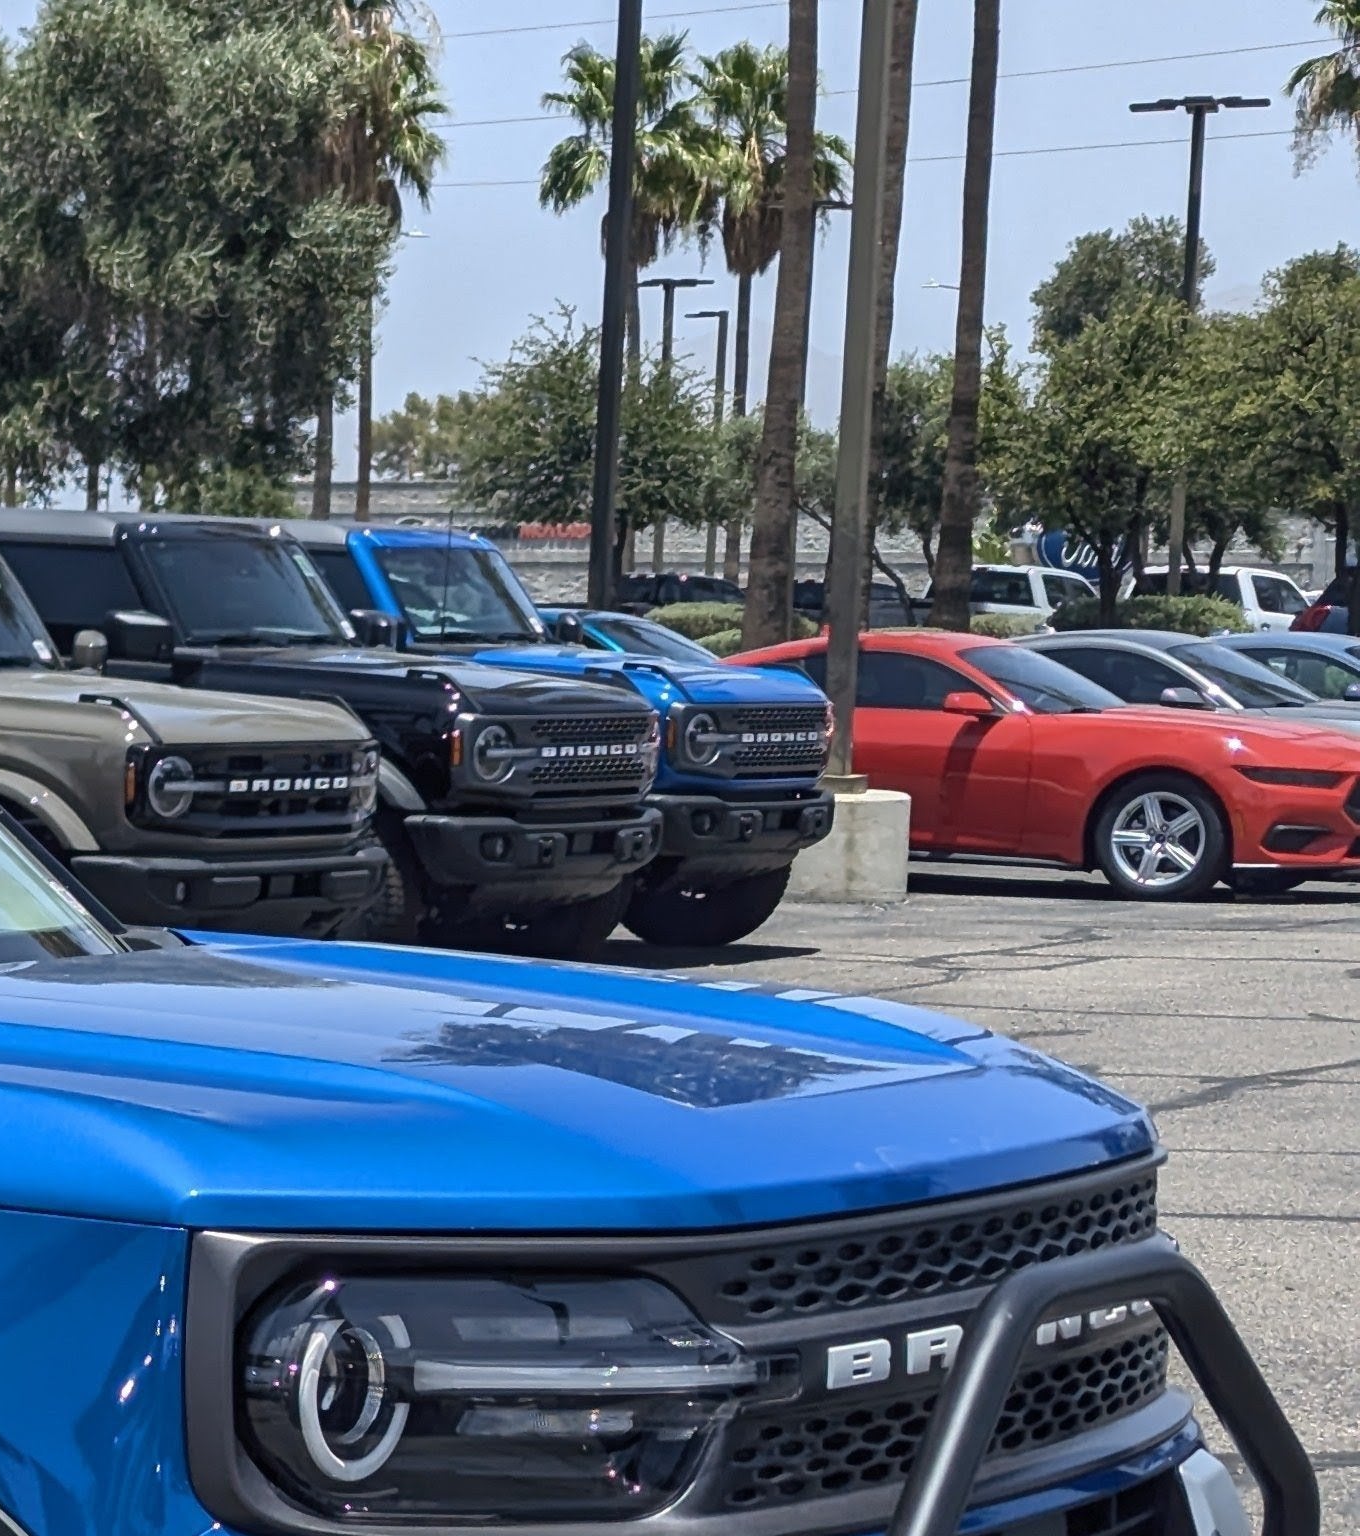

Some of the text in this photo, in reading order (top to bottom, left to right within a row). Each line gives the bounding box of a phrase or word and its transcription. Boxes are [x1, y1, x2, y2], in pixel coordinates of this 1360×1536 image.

[741, 731, 818, 742] BRONCO
[541, 744, 638, 757] BRONCO
[229, 776, 348, 792] BRONCO
[826, 1300, 1154, 1390] BRNC
